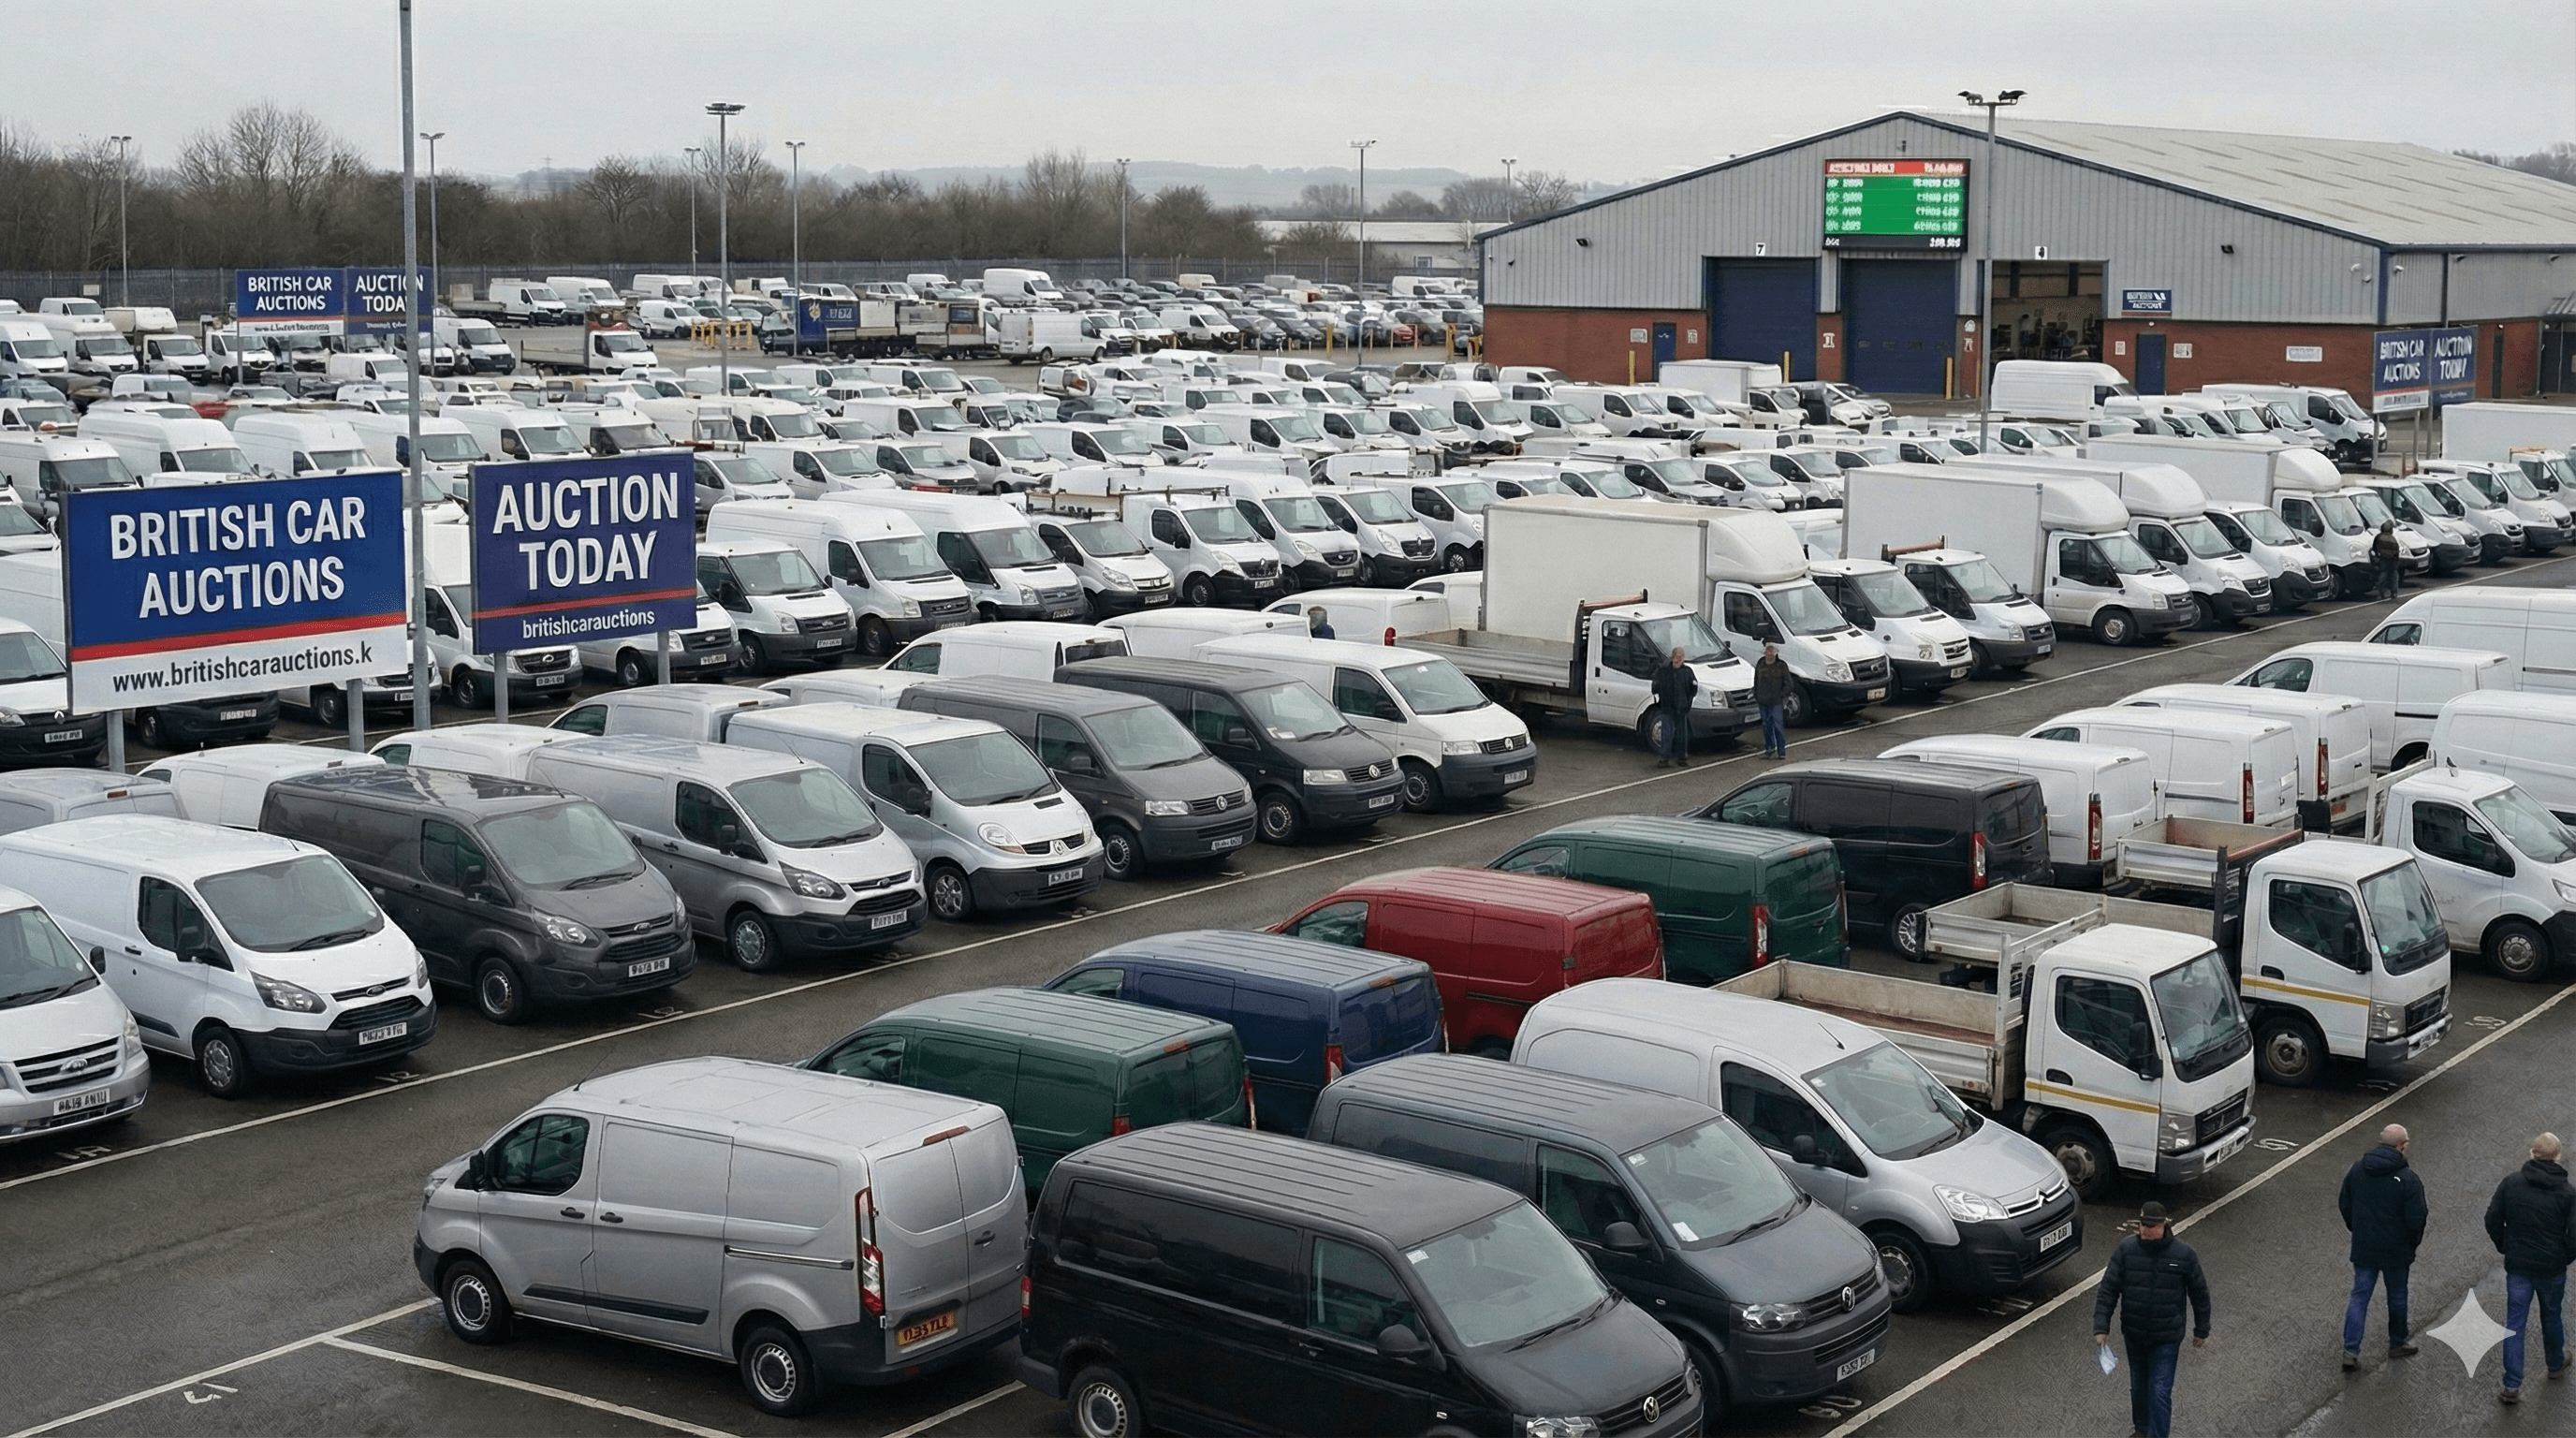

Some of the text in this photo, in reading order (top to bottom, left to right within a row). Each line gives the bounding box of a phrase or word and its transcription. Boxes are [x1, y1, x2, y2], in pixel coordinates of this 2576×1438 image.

[1757, 243, 1764, 255] 7
[248, 276, 332, 292] BRITISH CAR
[256, 295, 326, 311] AUCTIONS
[362, 295, 407, 312] TODA
[492, 472, 679, 534] AUCTION
[110, 496, 366, 560] BRITISH CAR
[519, 530, 657, 591] TODAY
[139, 556, 344, 619] AUCTIONS
[522, 609, 655, 638] britishcarauctions
[112, 640, 373, 693] www.britishcarauctions.k
